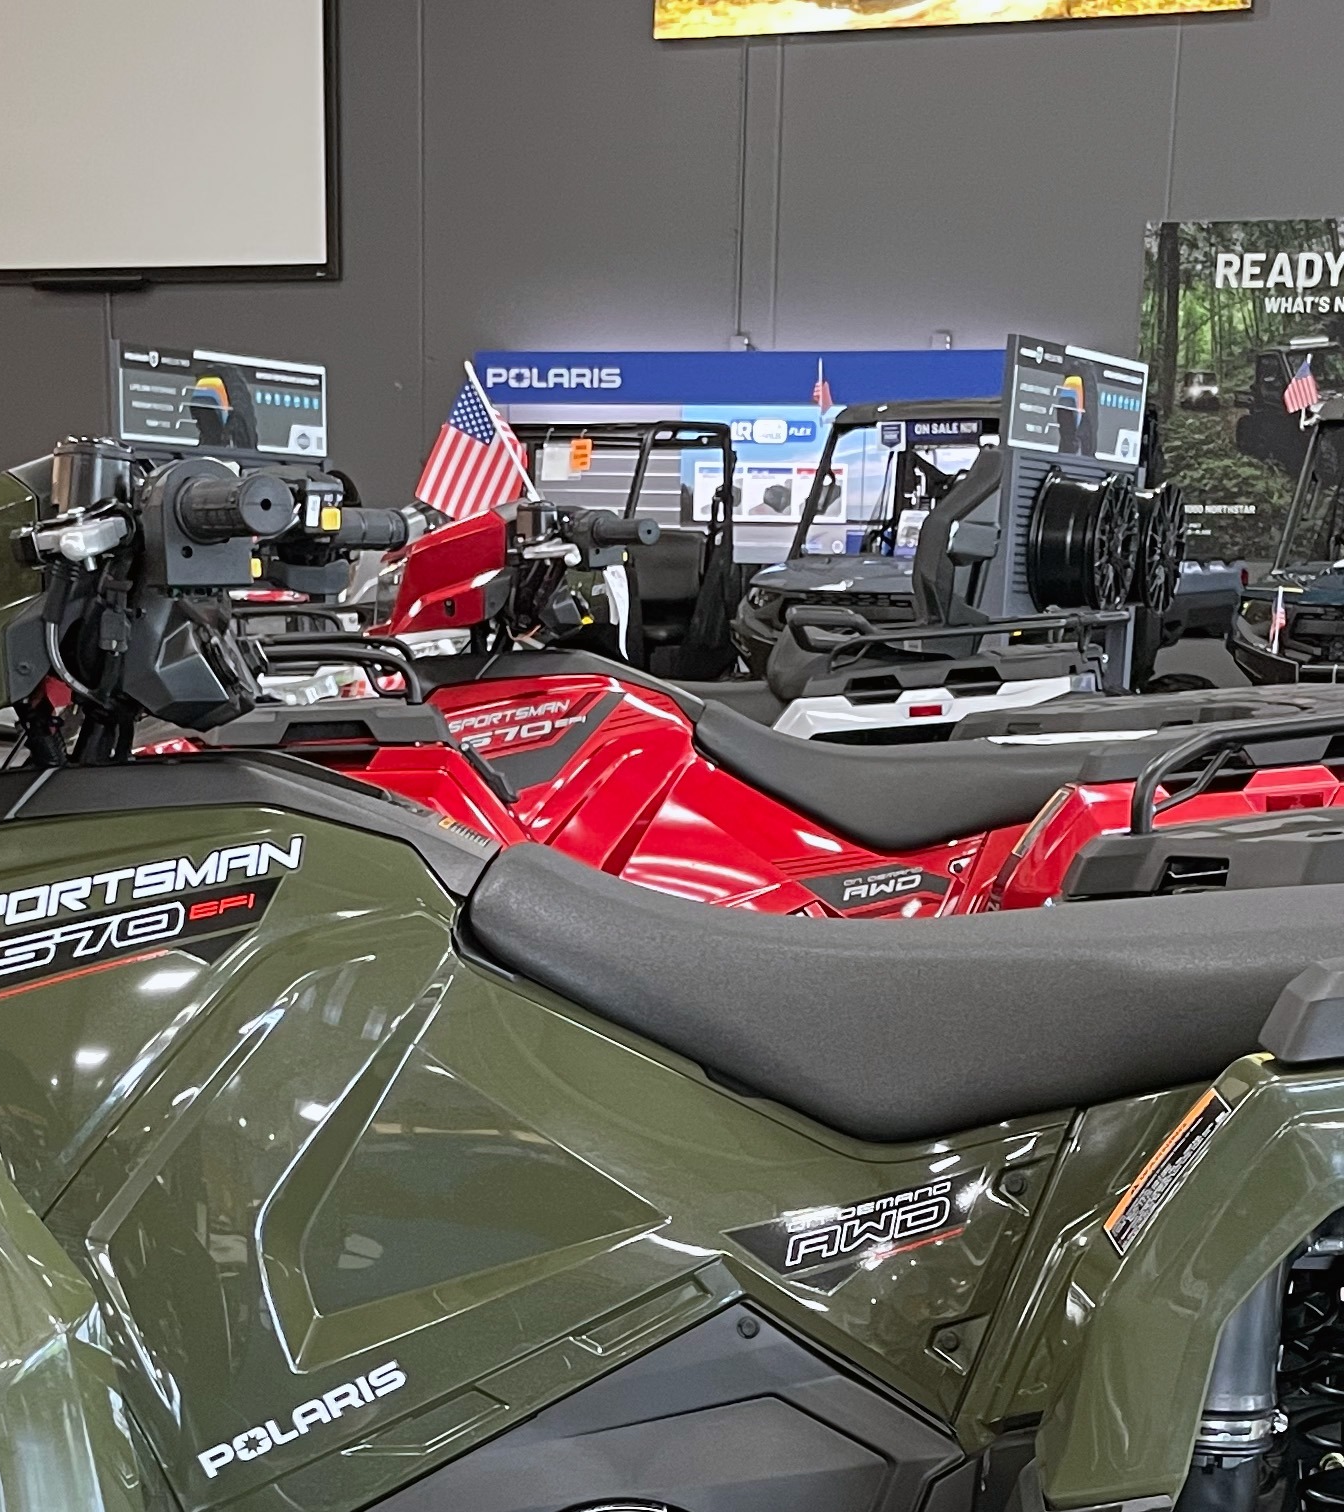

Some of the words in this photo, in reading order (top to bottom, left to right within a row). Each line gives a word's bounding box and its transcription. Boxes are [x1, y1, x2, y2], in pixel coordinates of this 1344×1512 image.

[486, 367, 622, 389] POLARIS
[914, 423, 930, 435] ON
[931, 422, 959, 434] SALE
[448, 699, 570, 733] SPORTSMAN
[461, 720, 553, 747] 570
[843, 874, 922, 901] AWD
[189, 893, 255, 921] EFI
[785, 1197, 952, 1267] AWD
[197, 1360, 407, 1479] POLARIS
